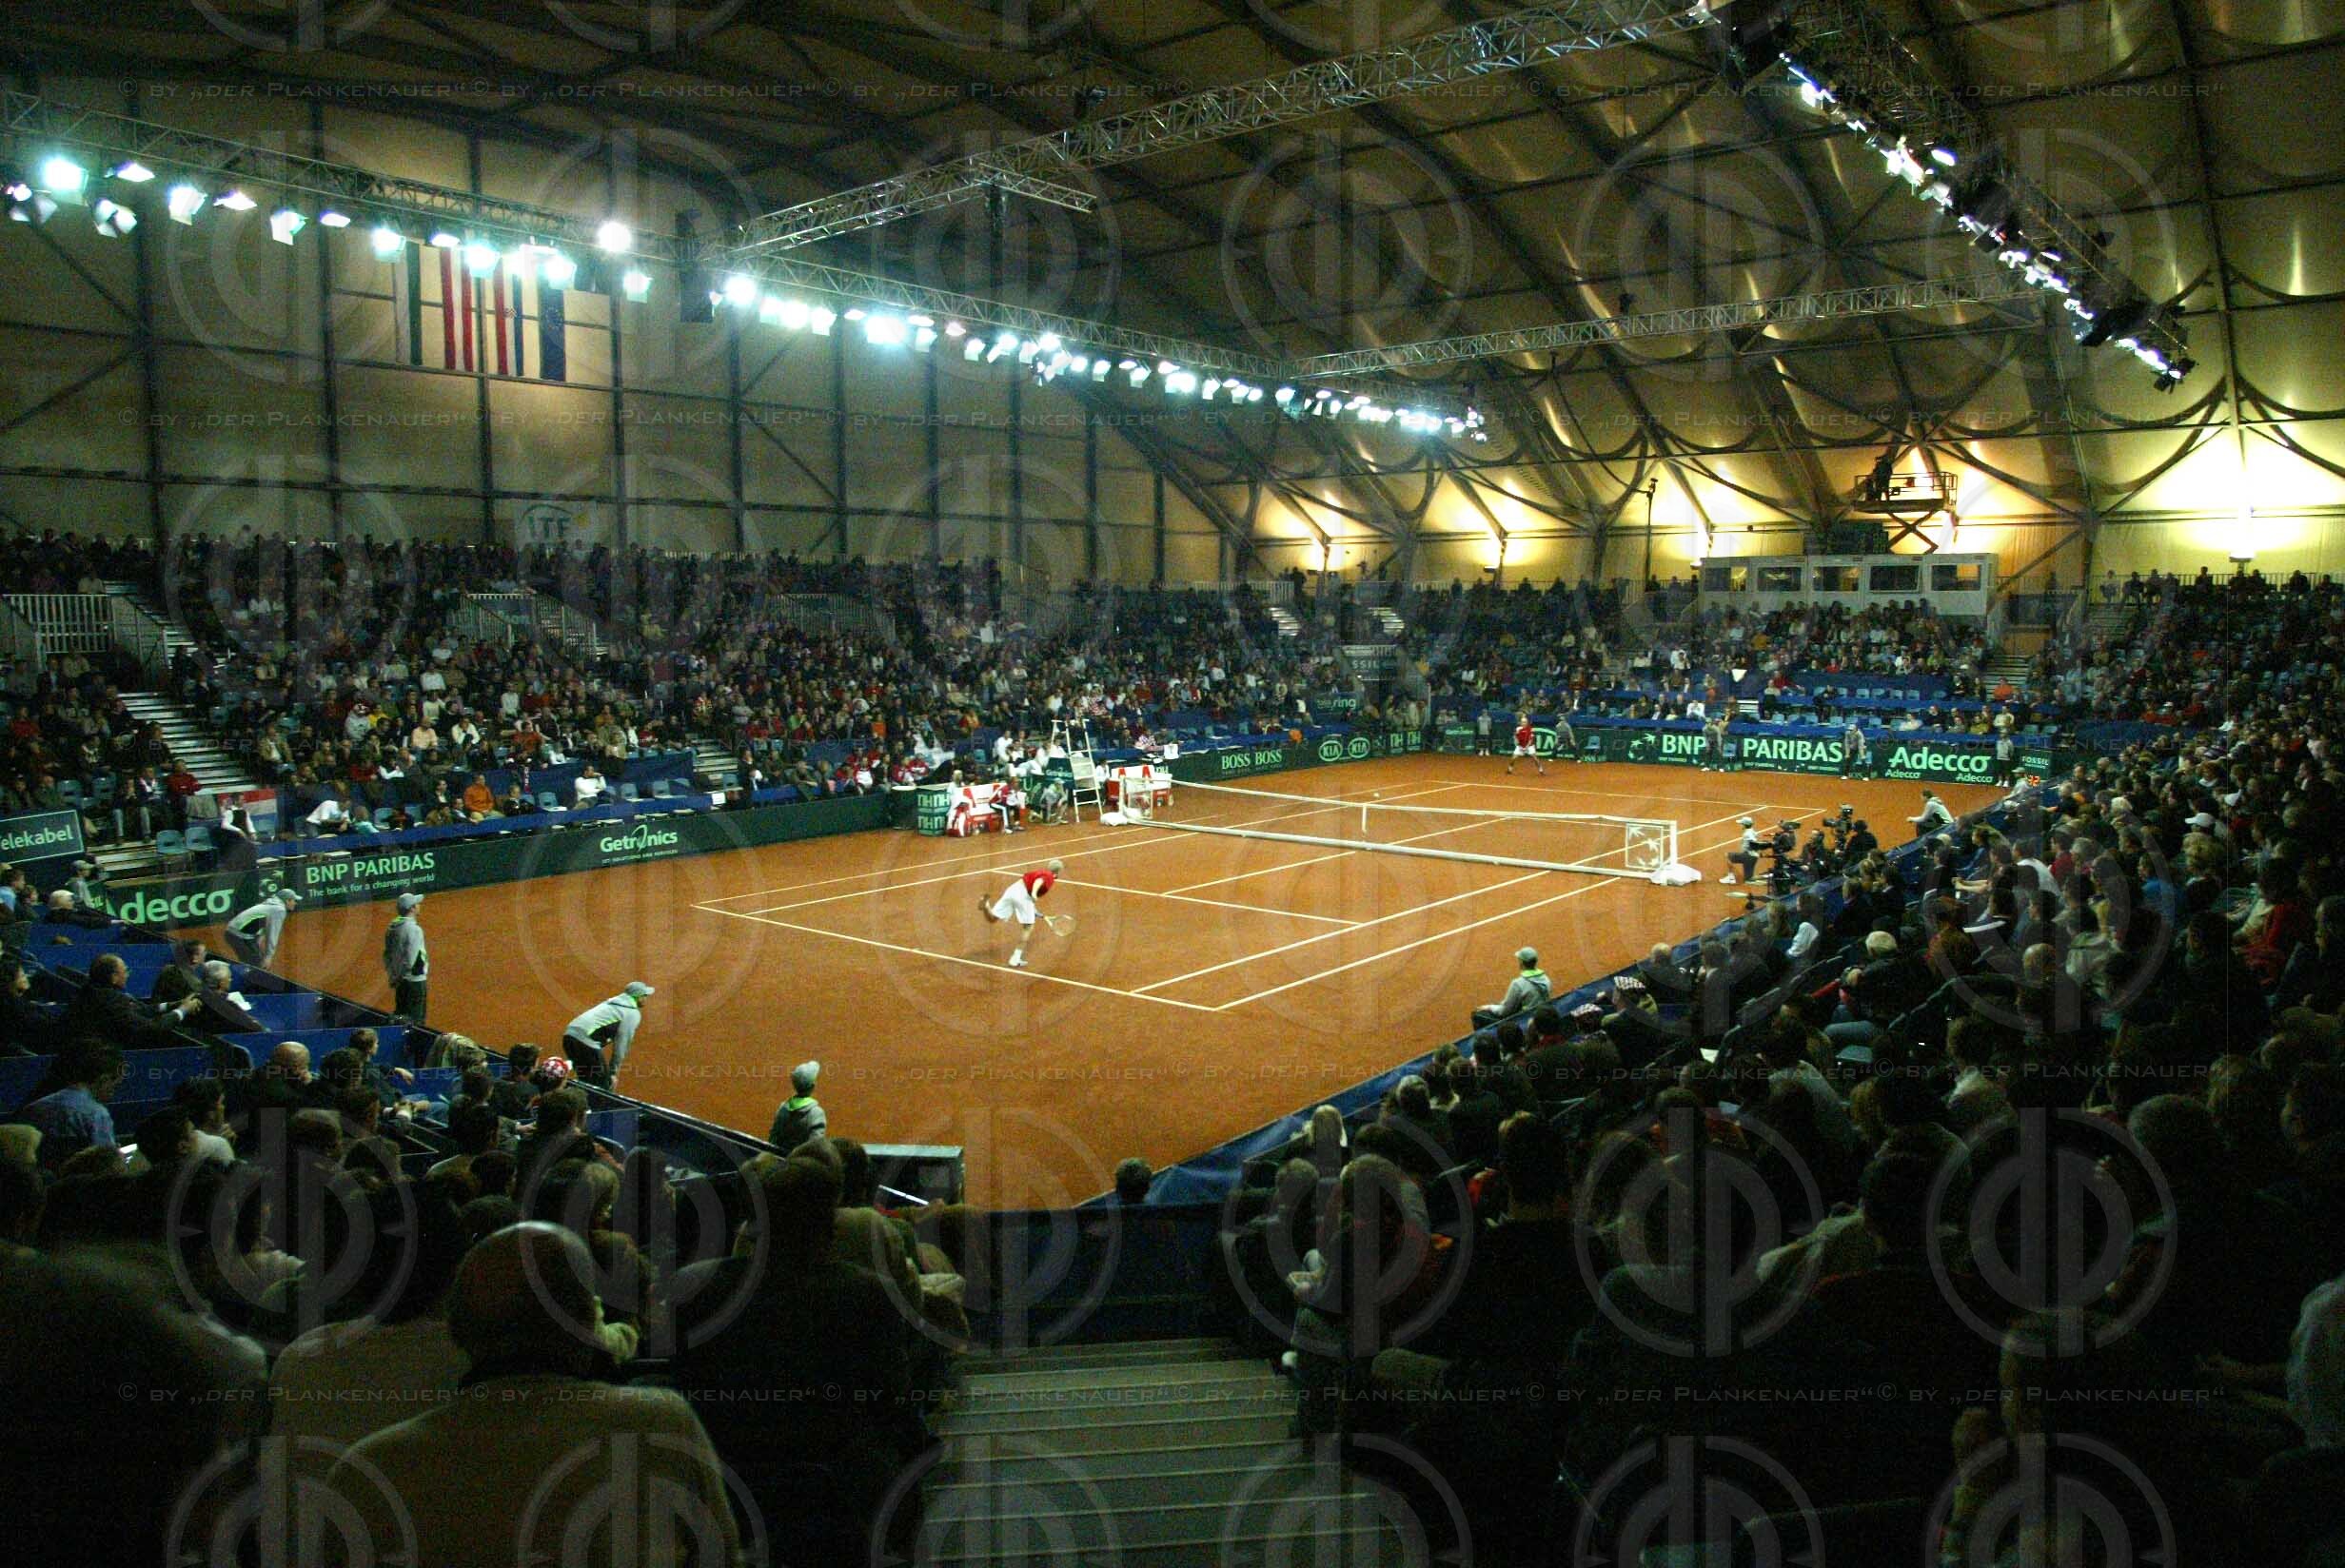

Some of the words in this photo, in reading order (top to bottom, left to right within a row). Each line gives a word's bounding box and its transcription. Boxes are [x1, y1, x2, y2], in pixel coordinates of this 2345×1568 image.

[1221, 753, 1251, 770] BOSS
[1255, 749, 1283, 766] BOSS
[1662, 734, 1706, 755] BNP
[1743, 737, 1843, 763] PARIBAS
[1888, 746, 1992, 774] Adecco
[1884, 769, 1921, 780] Adecco
[1956, 773, 1994, 784] Adecco
[0, 825, 74, 852] elekabel
[600, 824, 679, 853] Getronics
[305, 863, 348, 884] BNP
[353, 853, 435, 878] PARIBAS
[308, 889, 325, 897] The
[326, 886, 348, 895] bank
[350, 883, 364, 892] for
[372, 878, 411, 892] changing
[412, 873, 435, 884] world
